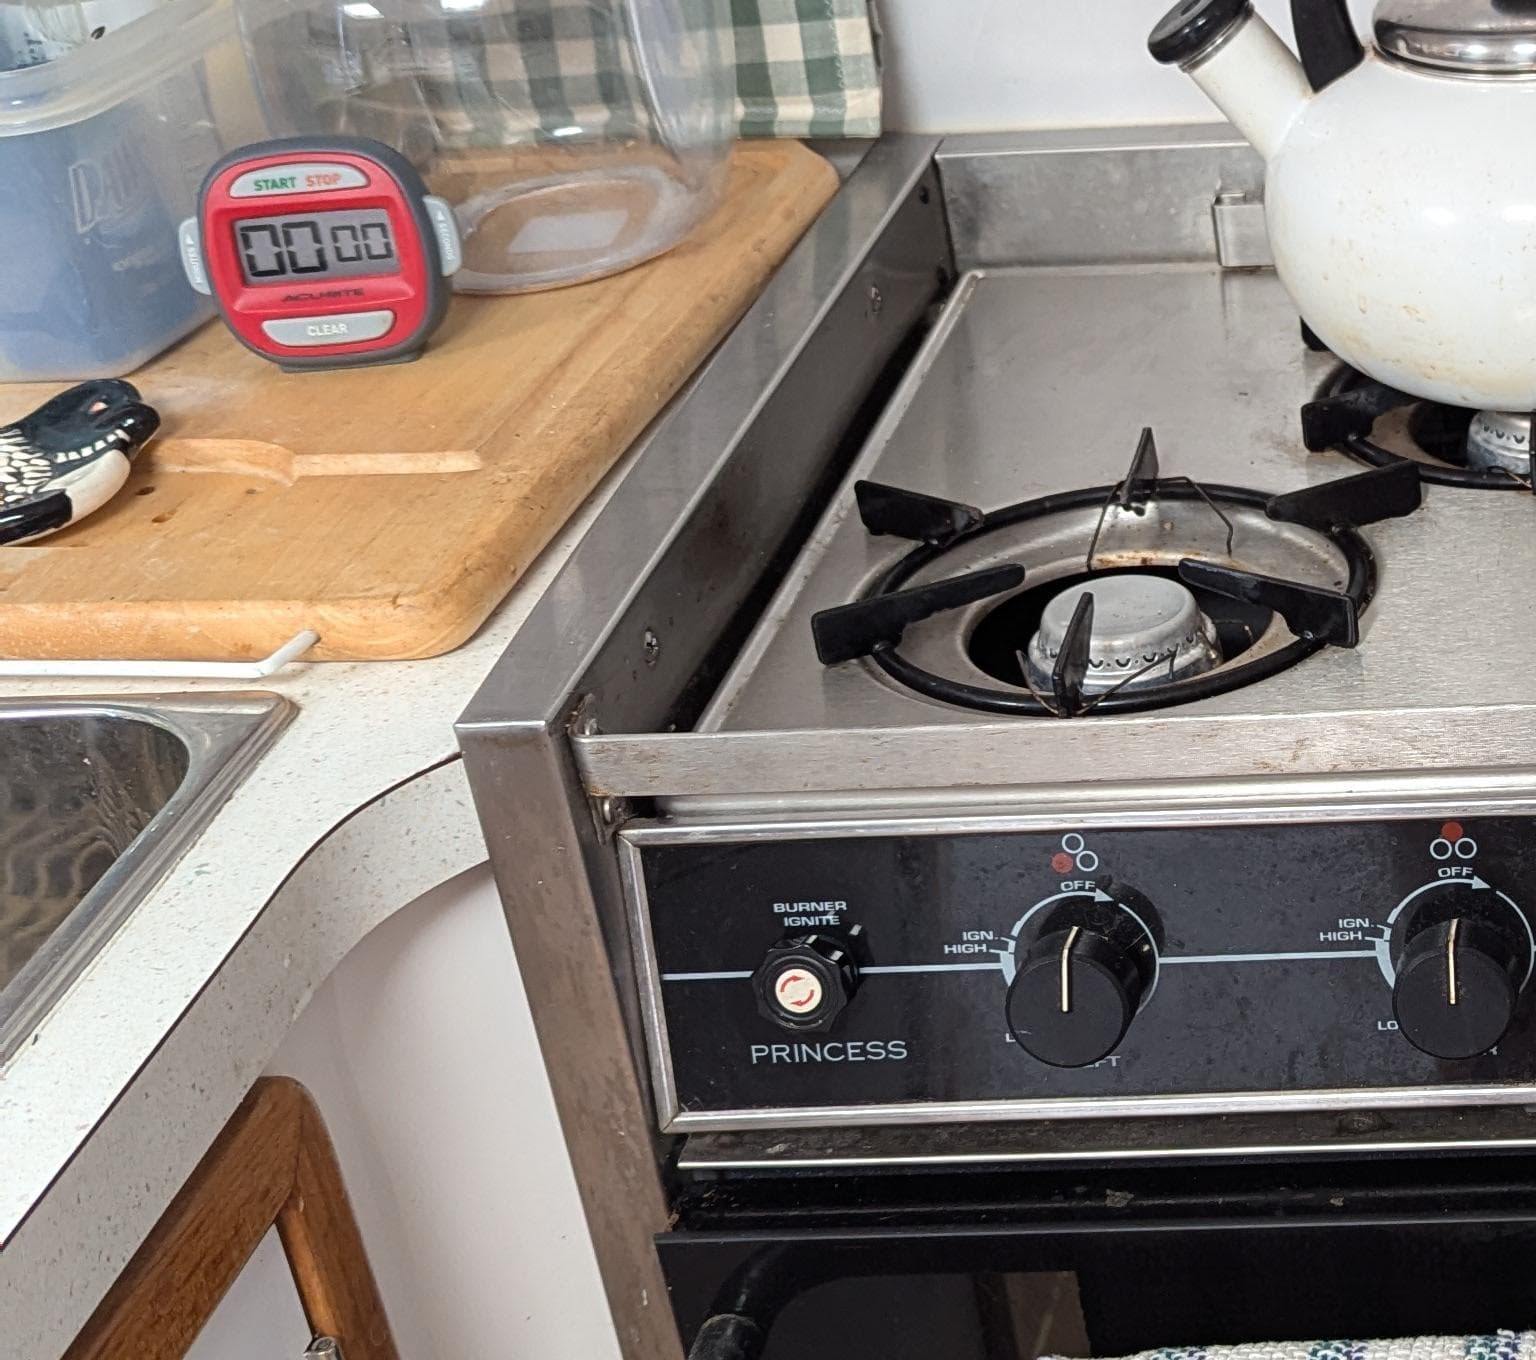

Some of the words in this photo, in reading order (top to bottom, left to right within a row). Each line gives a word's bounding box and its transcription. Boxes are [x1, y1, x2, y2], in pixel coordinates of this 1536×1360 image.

[254, 176, 297, 191] START
[305, 173, 343, 187] STOP
[307, 323, 349, 337] CLEAR
[1438, 866, 1474, 878] OFF
[1060, 880, 1096, 892] OFF
[773, 901, 848, 913] BURNER
[784, 915, 841, 927] IGNITE
[1338, 917, 1375, 929] IGN.
[962, 930, 998, 943] IGN.
[1319, 930, 1363, 941] HIGH
[944, 943, 987, 955] HIGH
[1377, 1020, 1399, 1031] LO
[751, 1041, 908, 1064] PRINCESS
